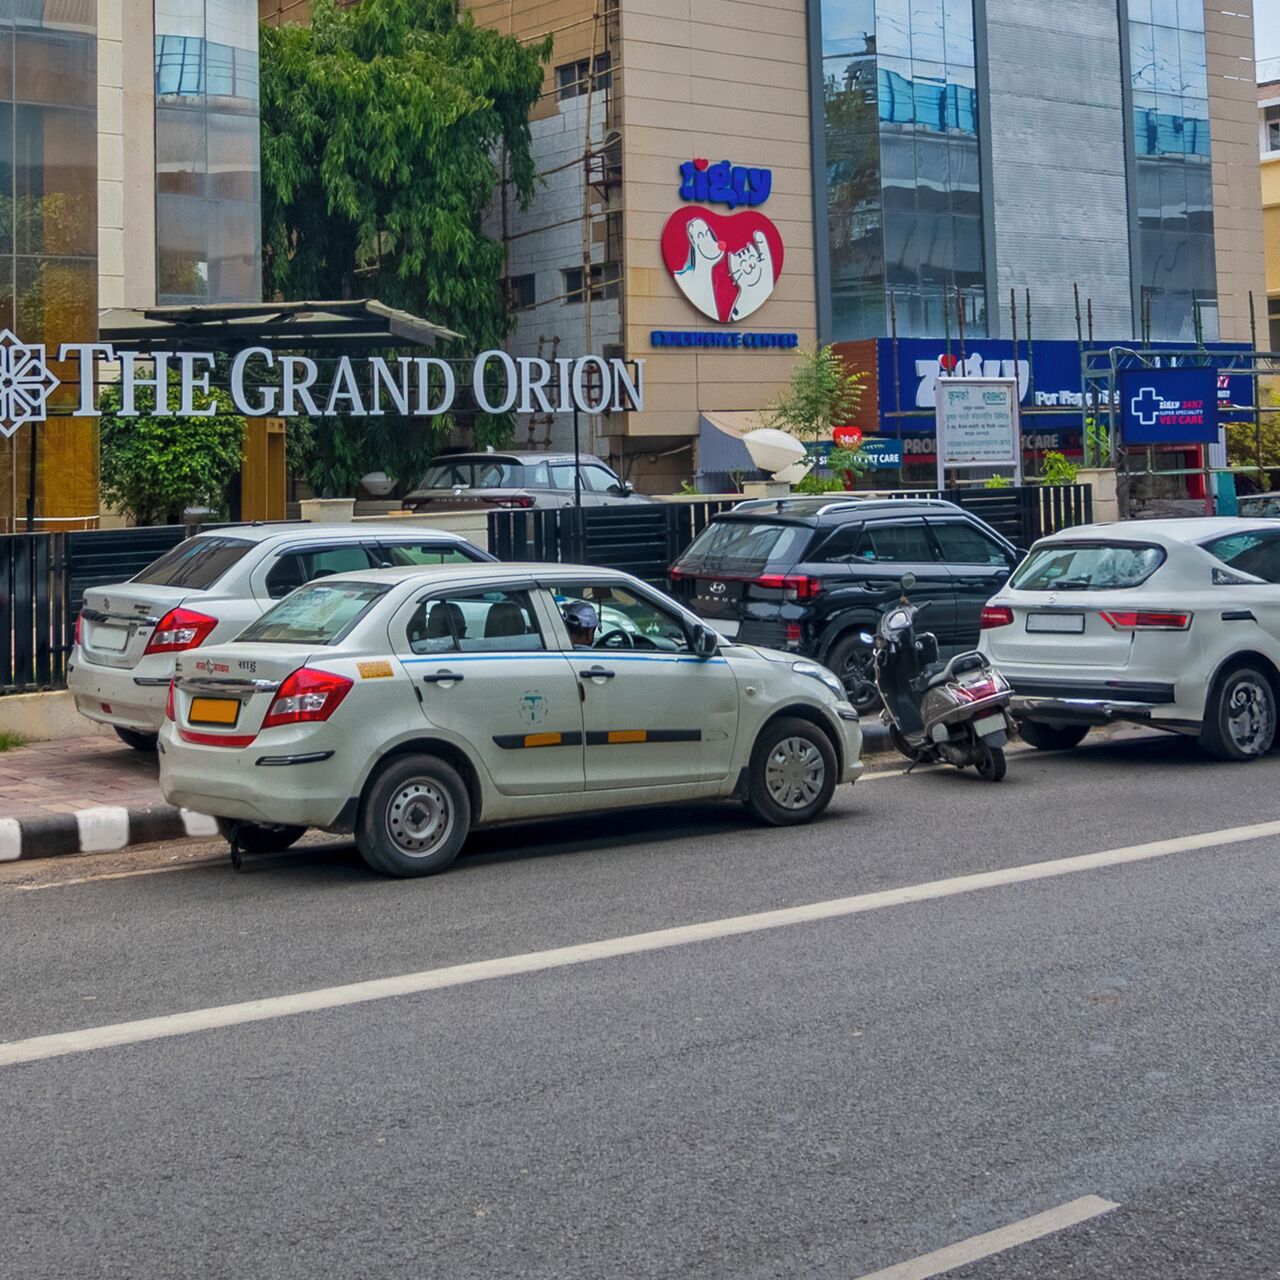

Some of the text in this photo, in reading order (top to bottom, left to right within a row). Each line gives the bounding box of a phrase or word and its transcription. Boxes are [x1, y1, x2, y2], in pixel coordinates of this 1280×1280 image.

[59, 342, 646, 417] THE GRAND ORION
[1160, 415, 1203, 424] VET CARE
[879, 453, 900, 463] CARE
